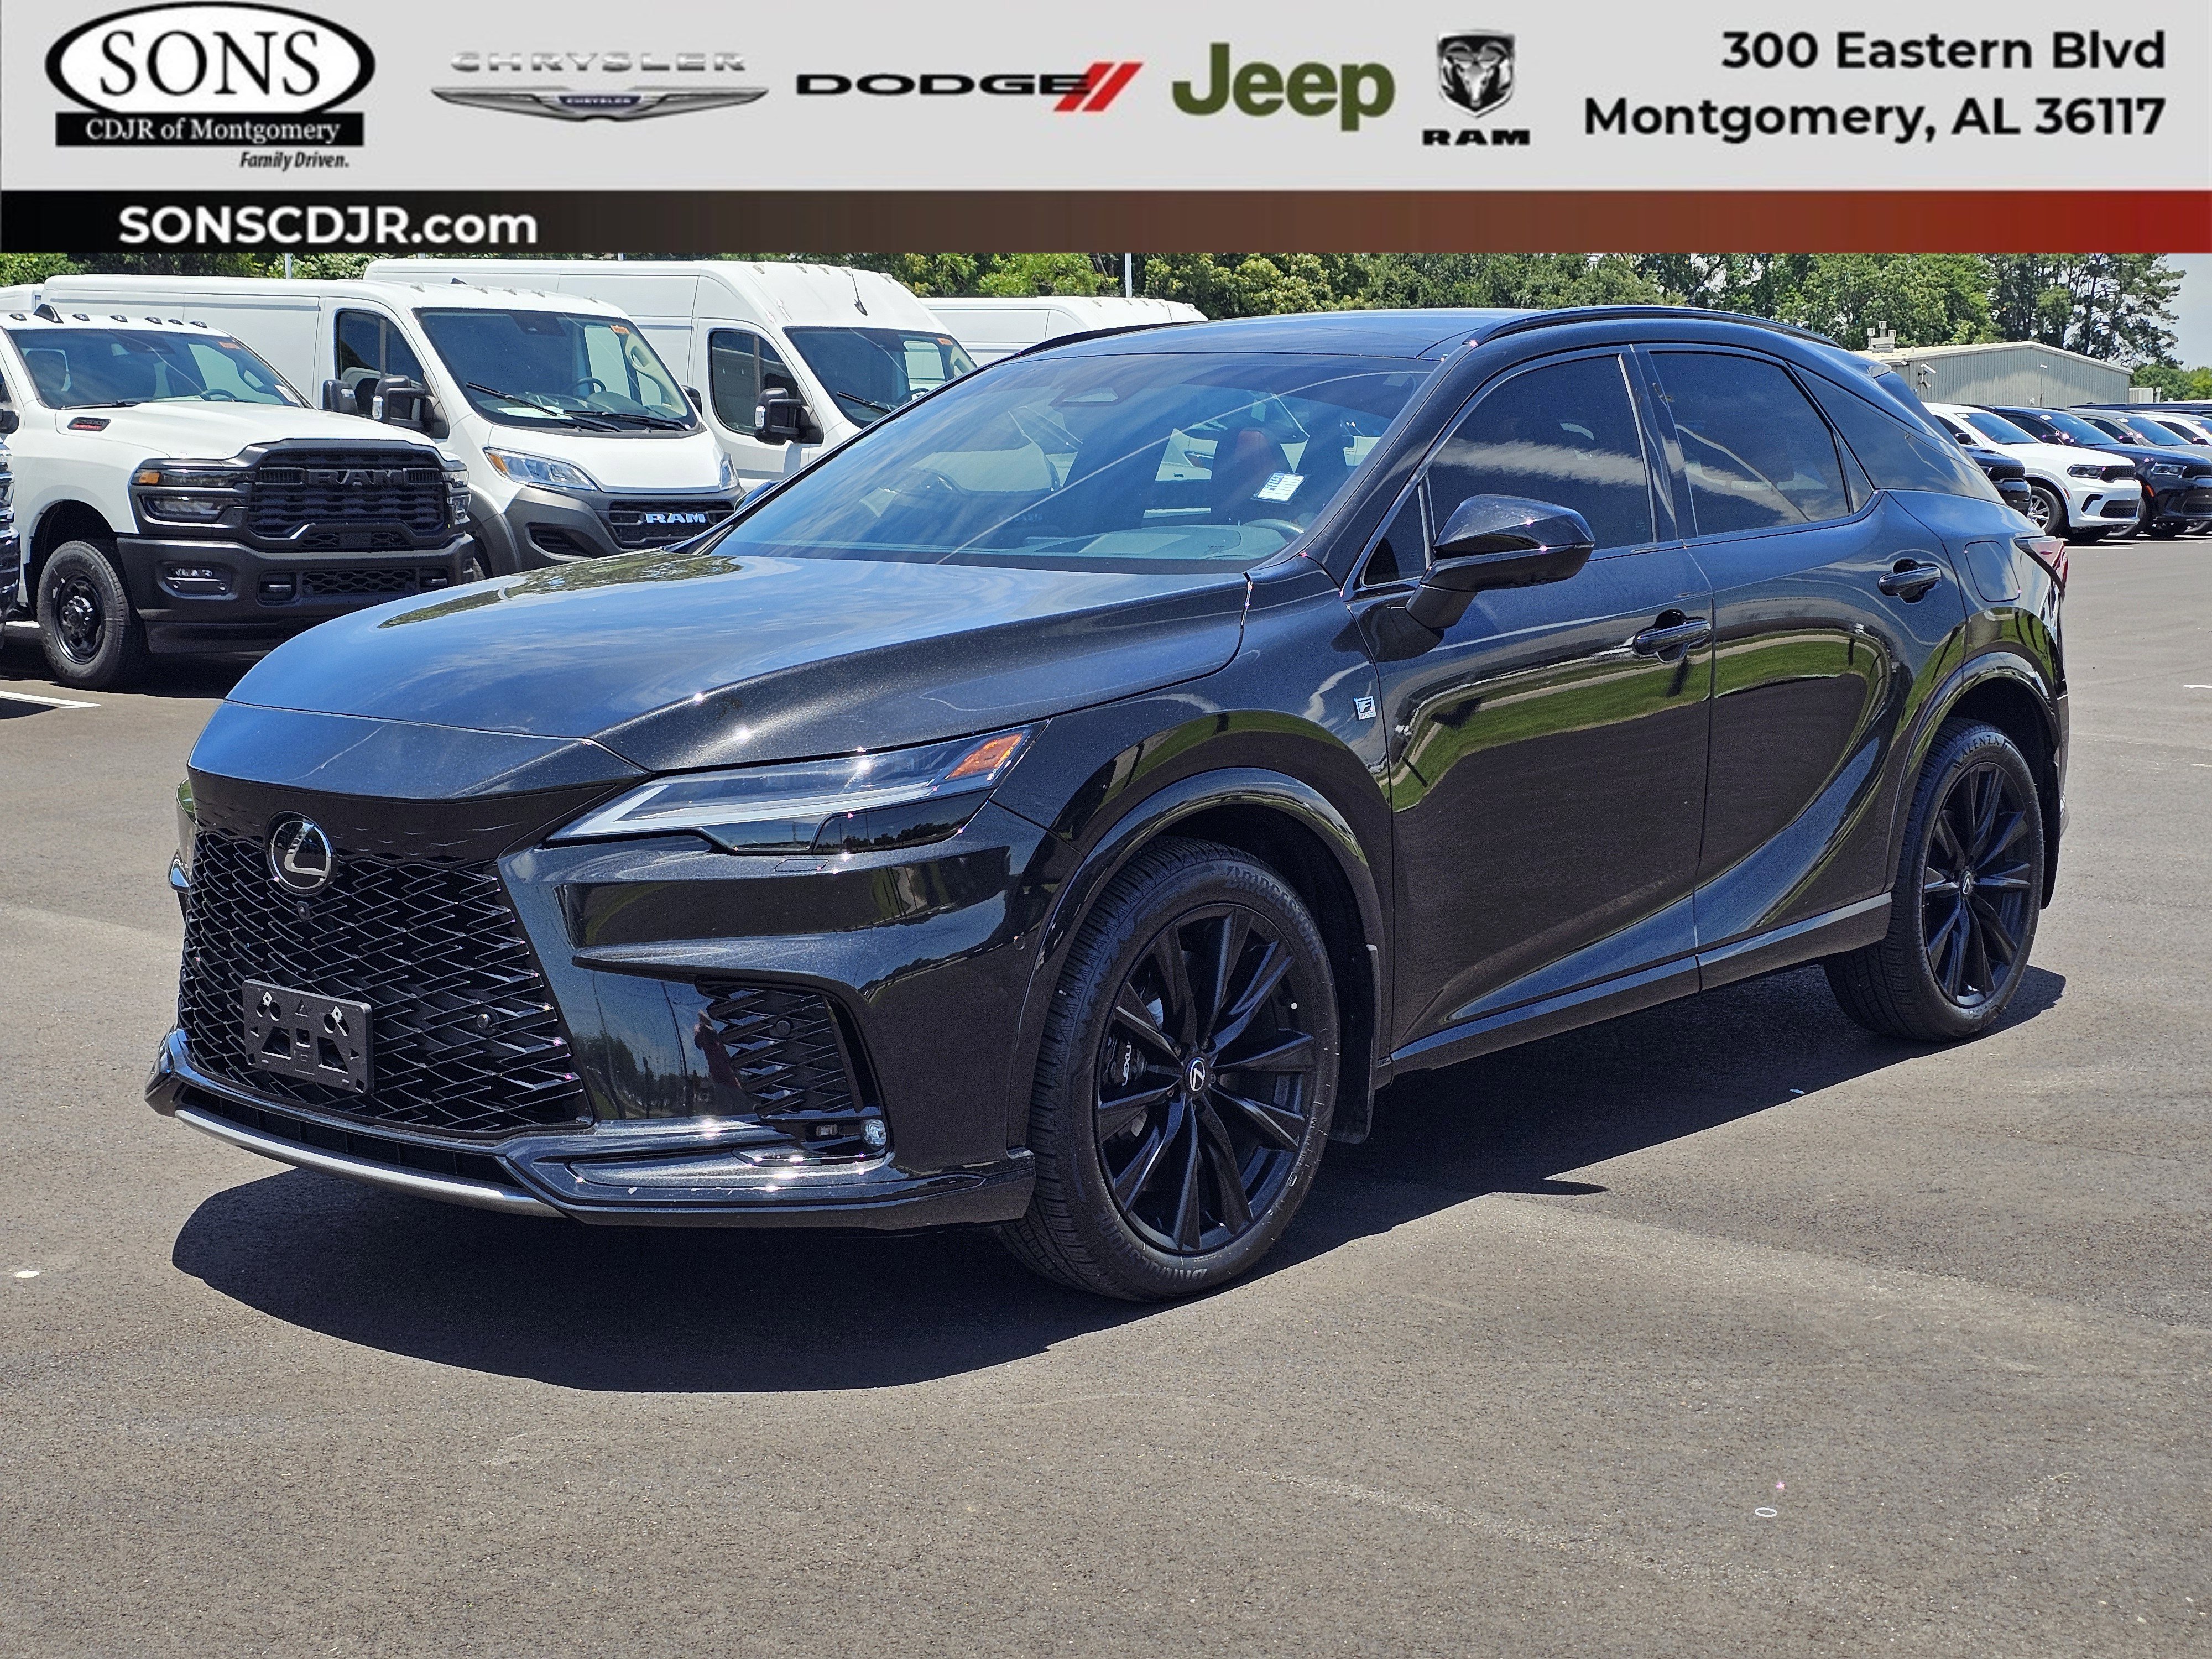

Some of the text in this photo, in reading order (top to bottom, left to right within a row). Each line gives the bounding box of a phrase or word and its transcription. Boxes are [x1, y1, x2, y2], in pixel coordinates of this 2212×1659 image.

[306, 469, 403, 486] RAM
[645, 512, 707, 523] RAM
[1961, 735, 2000, 759] ALENZA
[1224, 865, 1321, 962] BRIDGESTONE
[1121, 1041, 1132, 1086] LEXU
